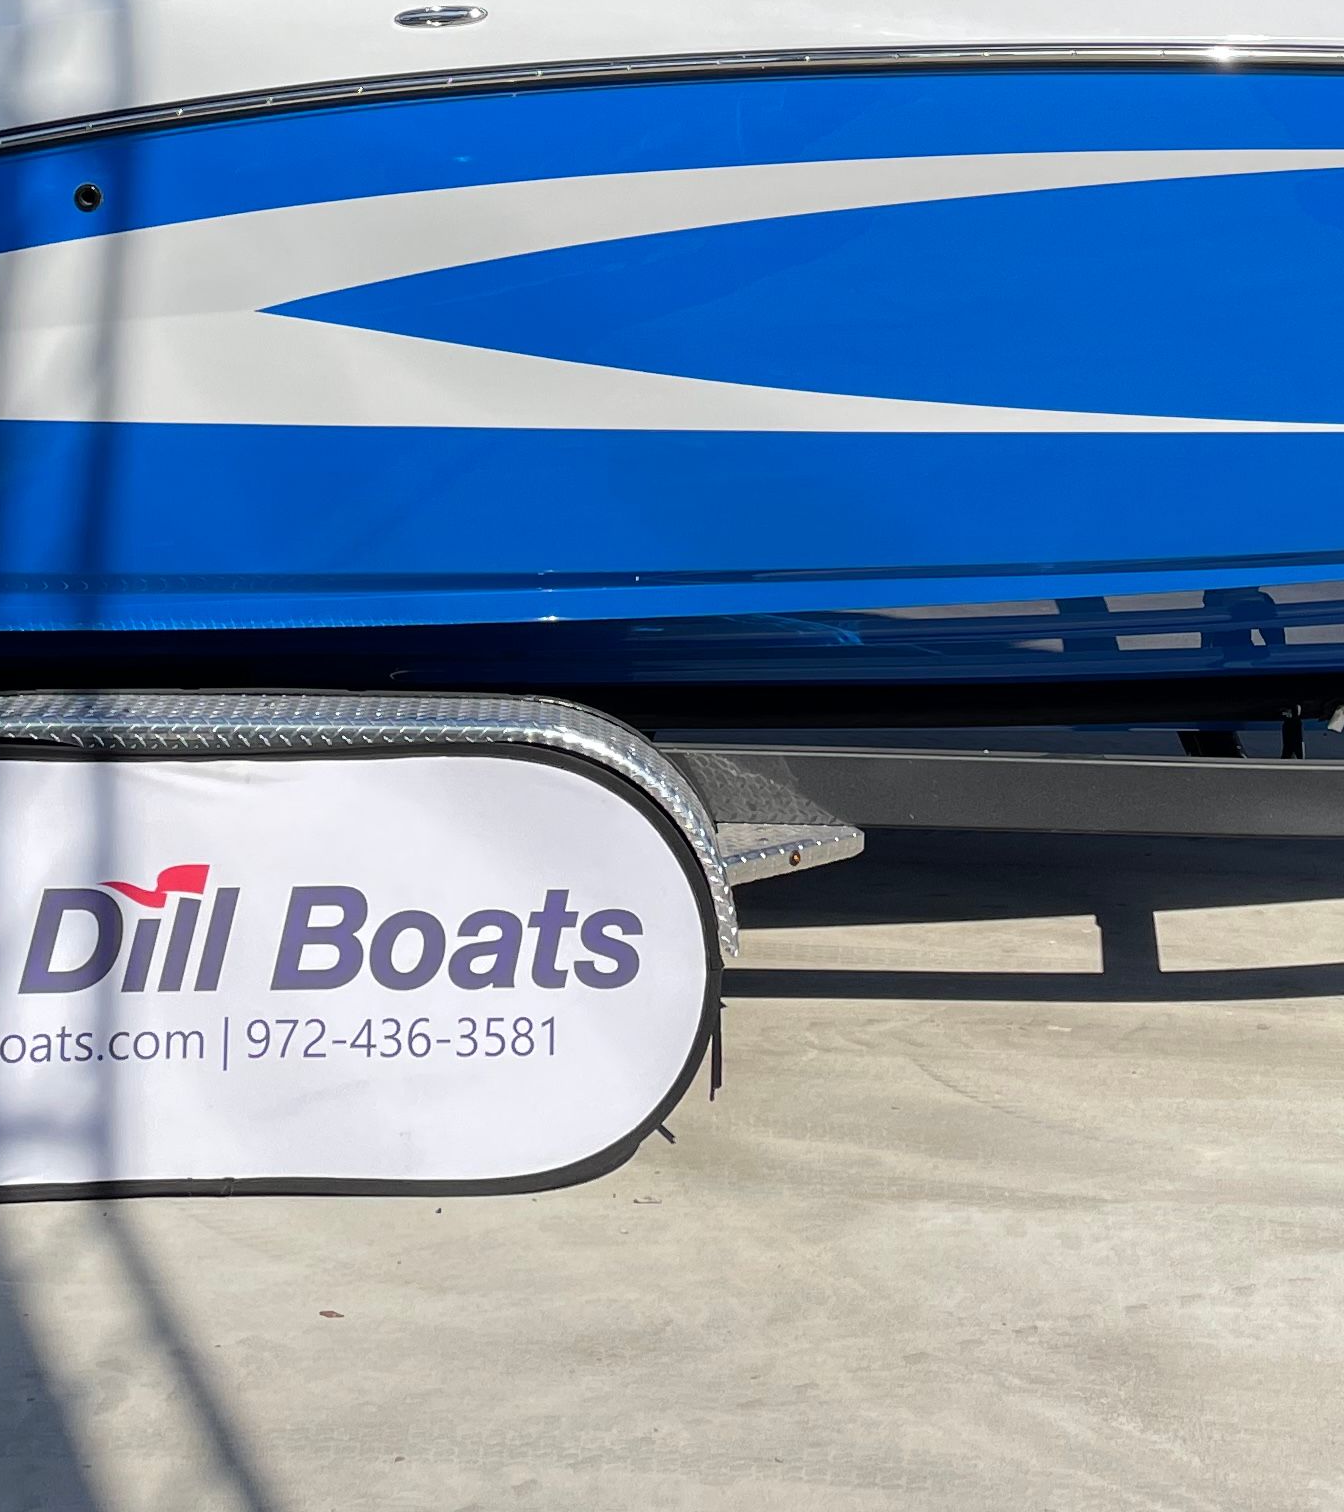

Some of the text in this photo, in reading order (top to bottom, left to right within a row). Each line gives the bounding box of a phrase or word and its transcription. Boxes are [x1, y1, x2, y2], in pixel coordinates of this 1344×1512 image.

[17, 887, 242, 995] Dill
[269, 885, 644, 992] Boats
[246, 1016, 558, 1060] 972-436-3581
